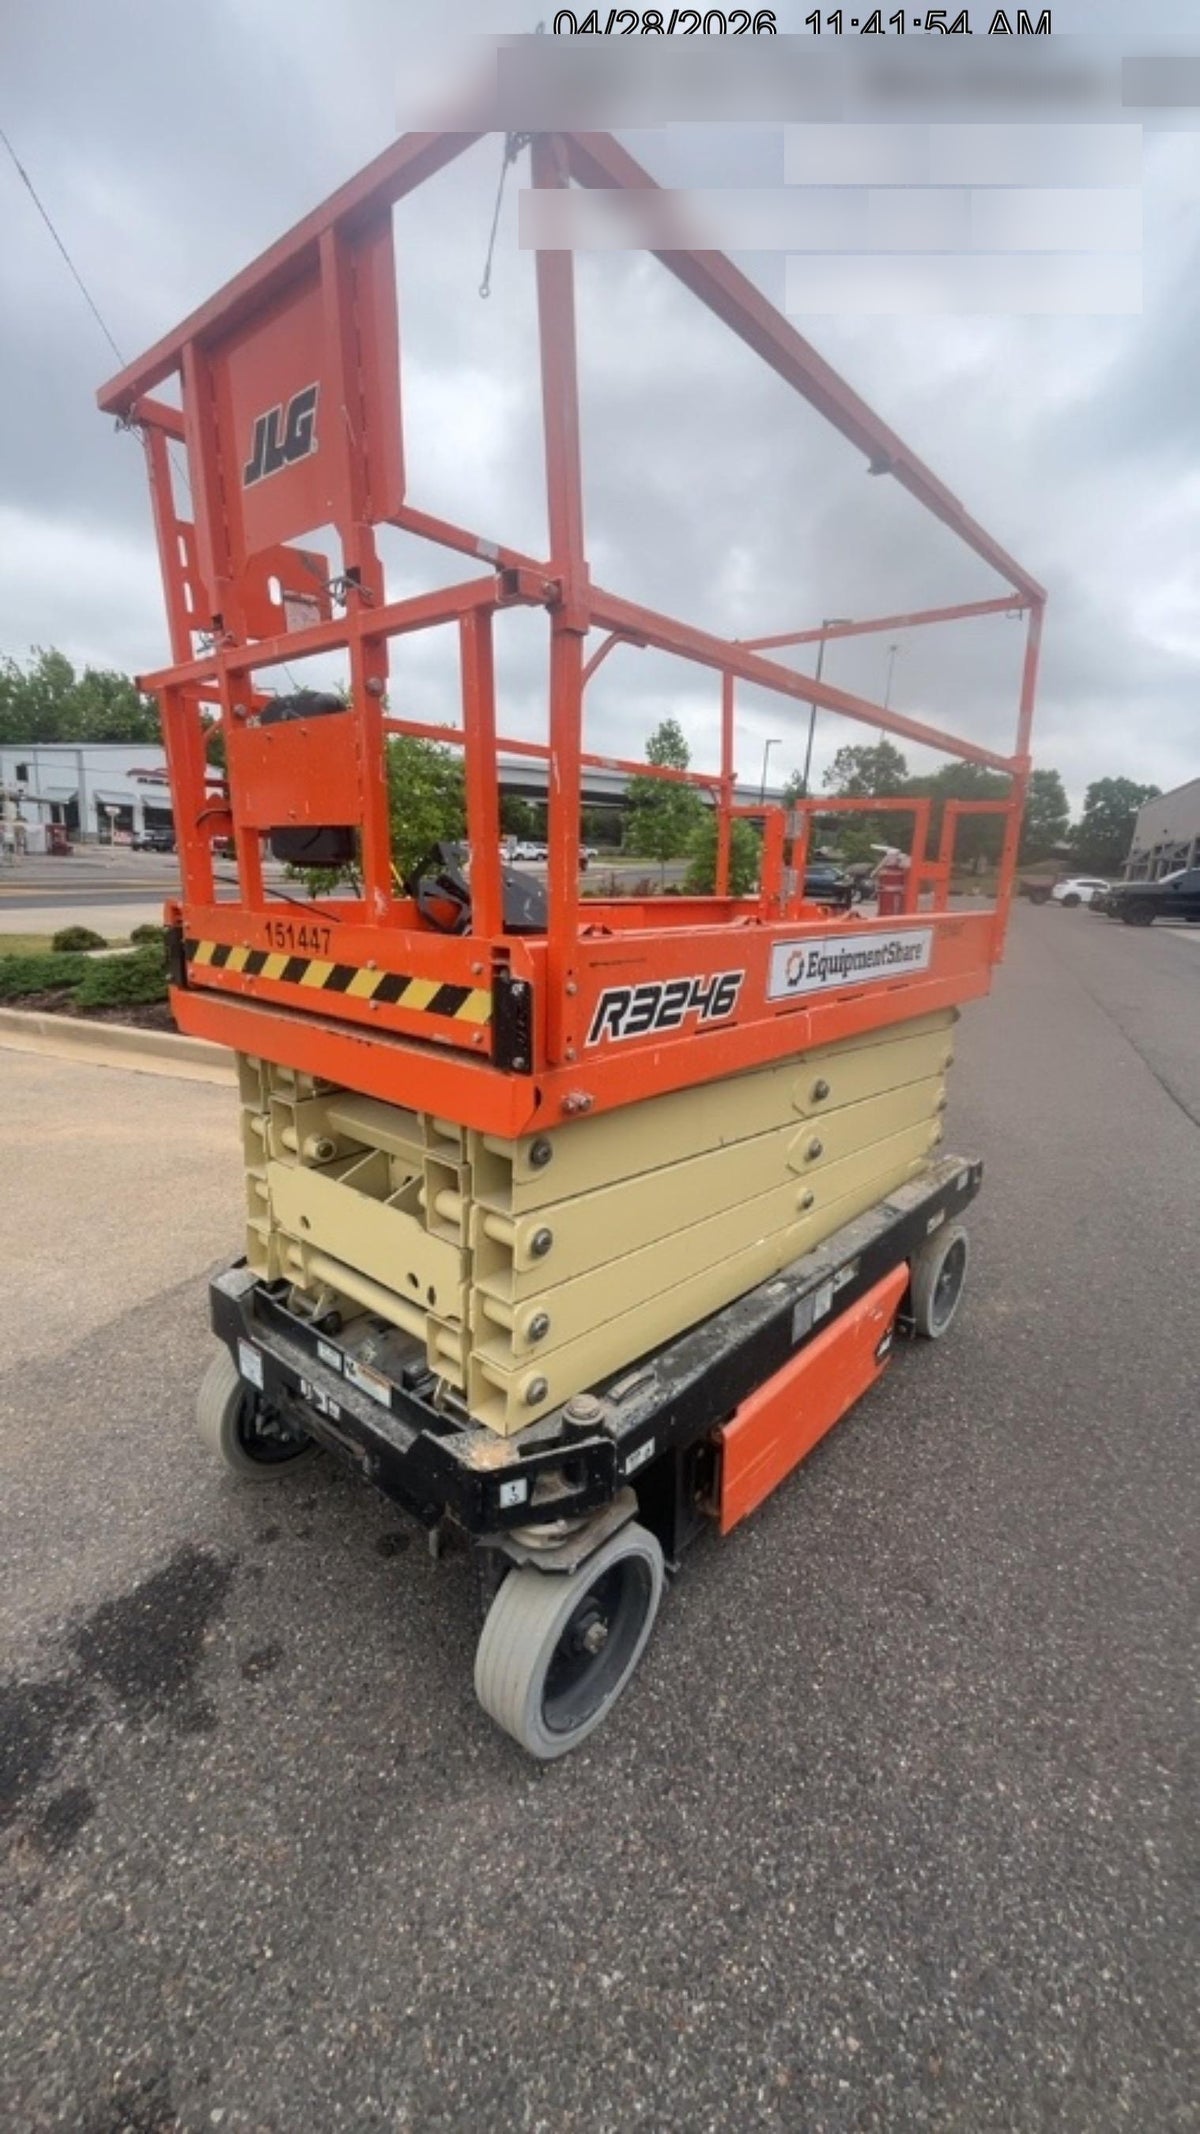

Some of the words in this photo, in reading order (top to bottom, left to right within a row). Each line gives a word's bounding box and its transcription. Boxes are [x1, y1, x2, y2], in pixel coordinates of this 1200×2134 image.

[243, 381, 319, 488] JLG
[265, 921, 331, 955] 151447
[806, 941, 922, 981] EquipmentShare
[585, 970, 745, 1047] R3246
